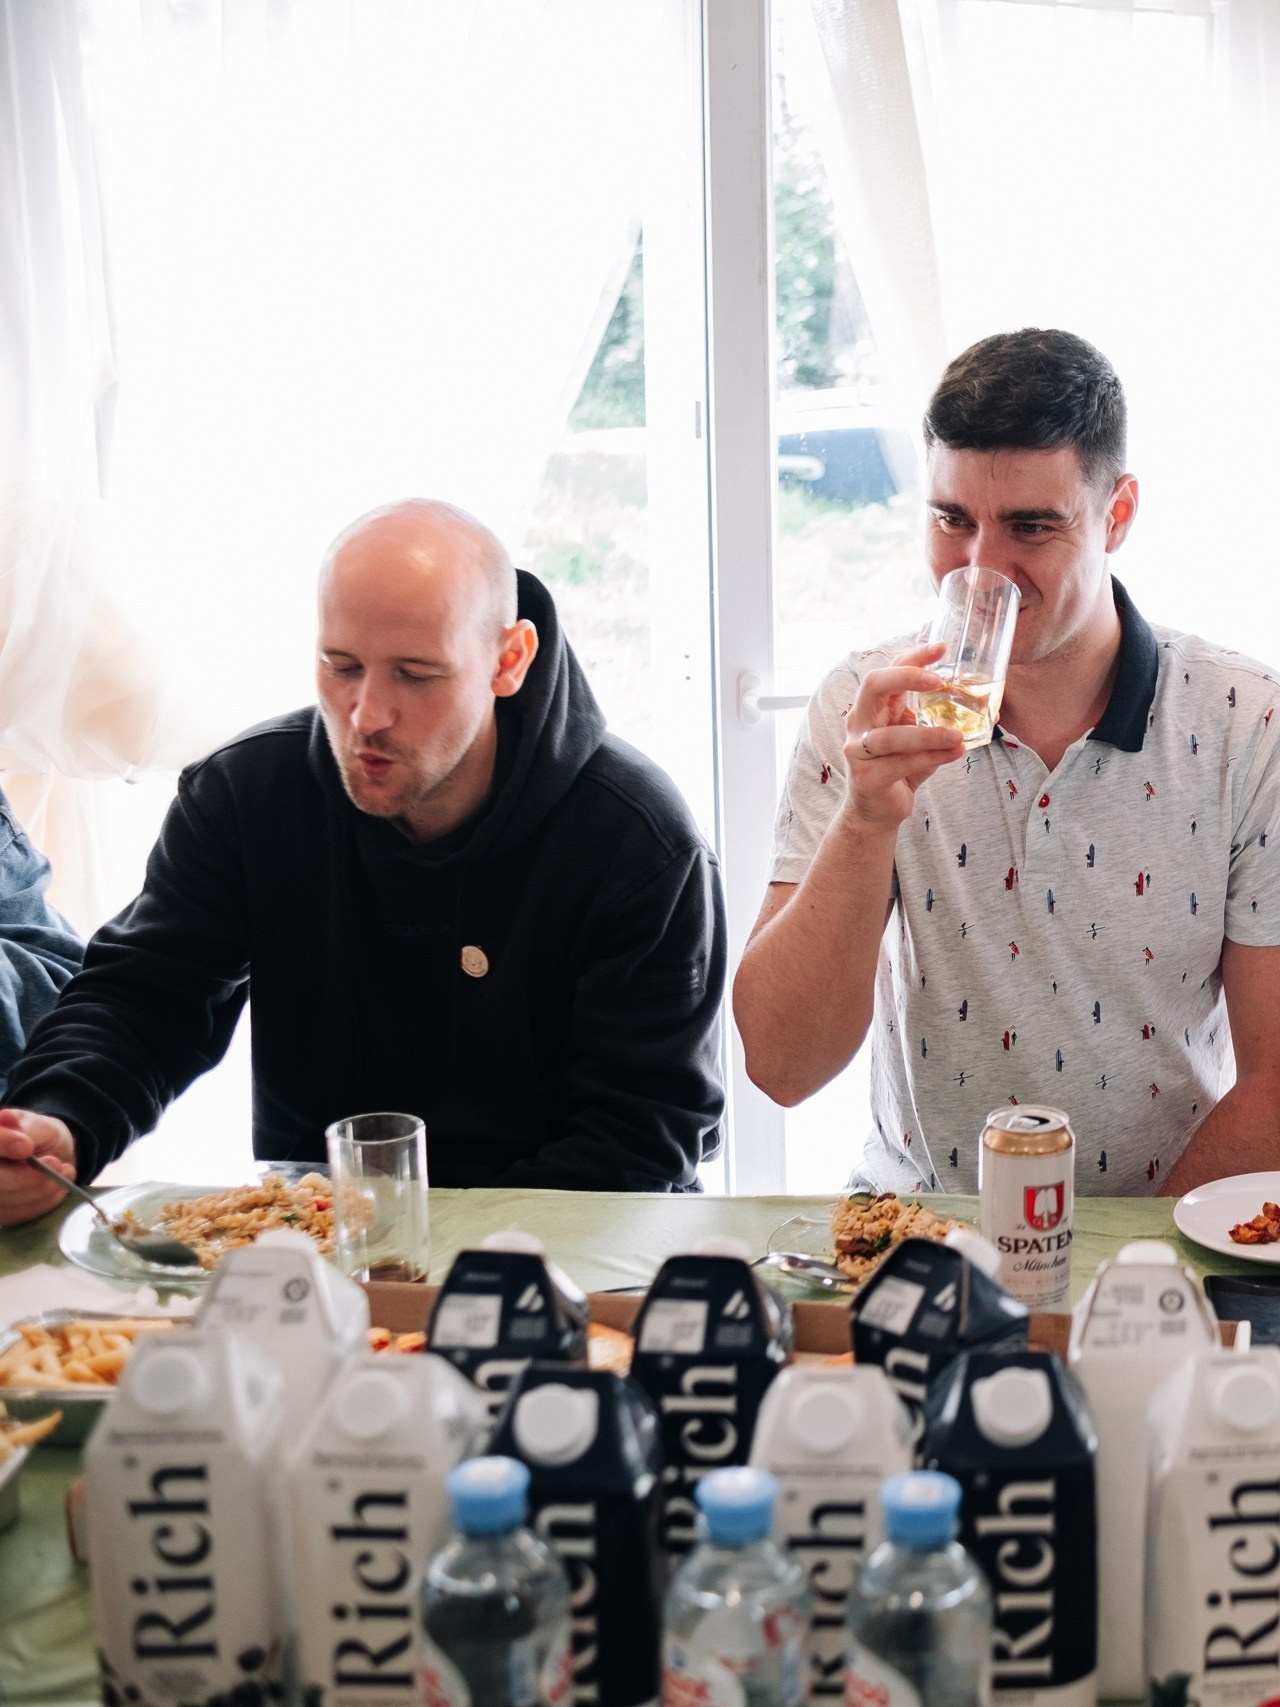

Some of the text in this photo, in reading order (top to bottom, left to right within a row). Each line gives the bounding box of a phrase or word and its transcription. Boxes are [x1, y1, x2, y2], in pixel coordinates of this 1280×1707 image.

[997, 1229, 1072, 1254] SPATEN
[1013, 1257, 1067, 1272] München
[126, 1462, 219, 1661] Rich
[328, 1489, 417, 1689] Rich
